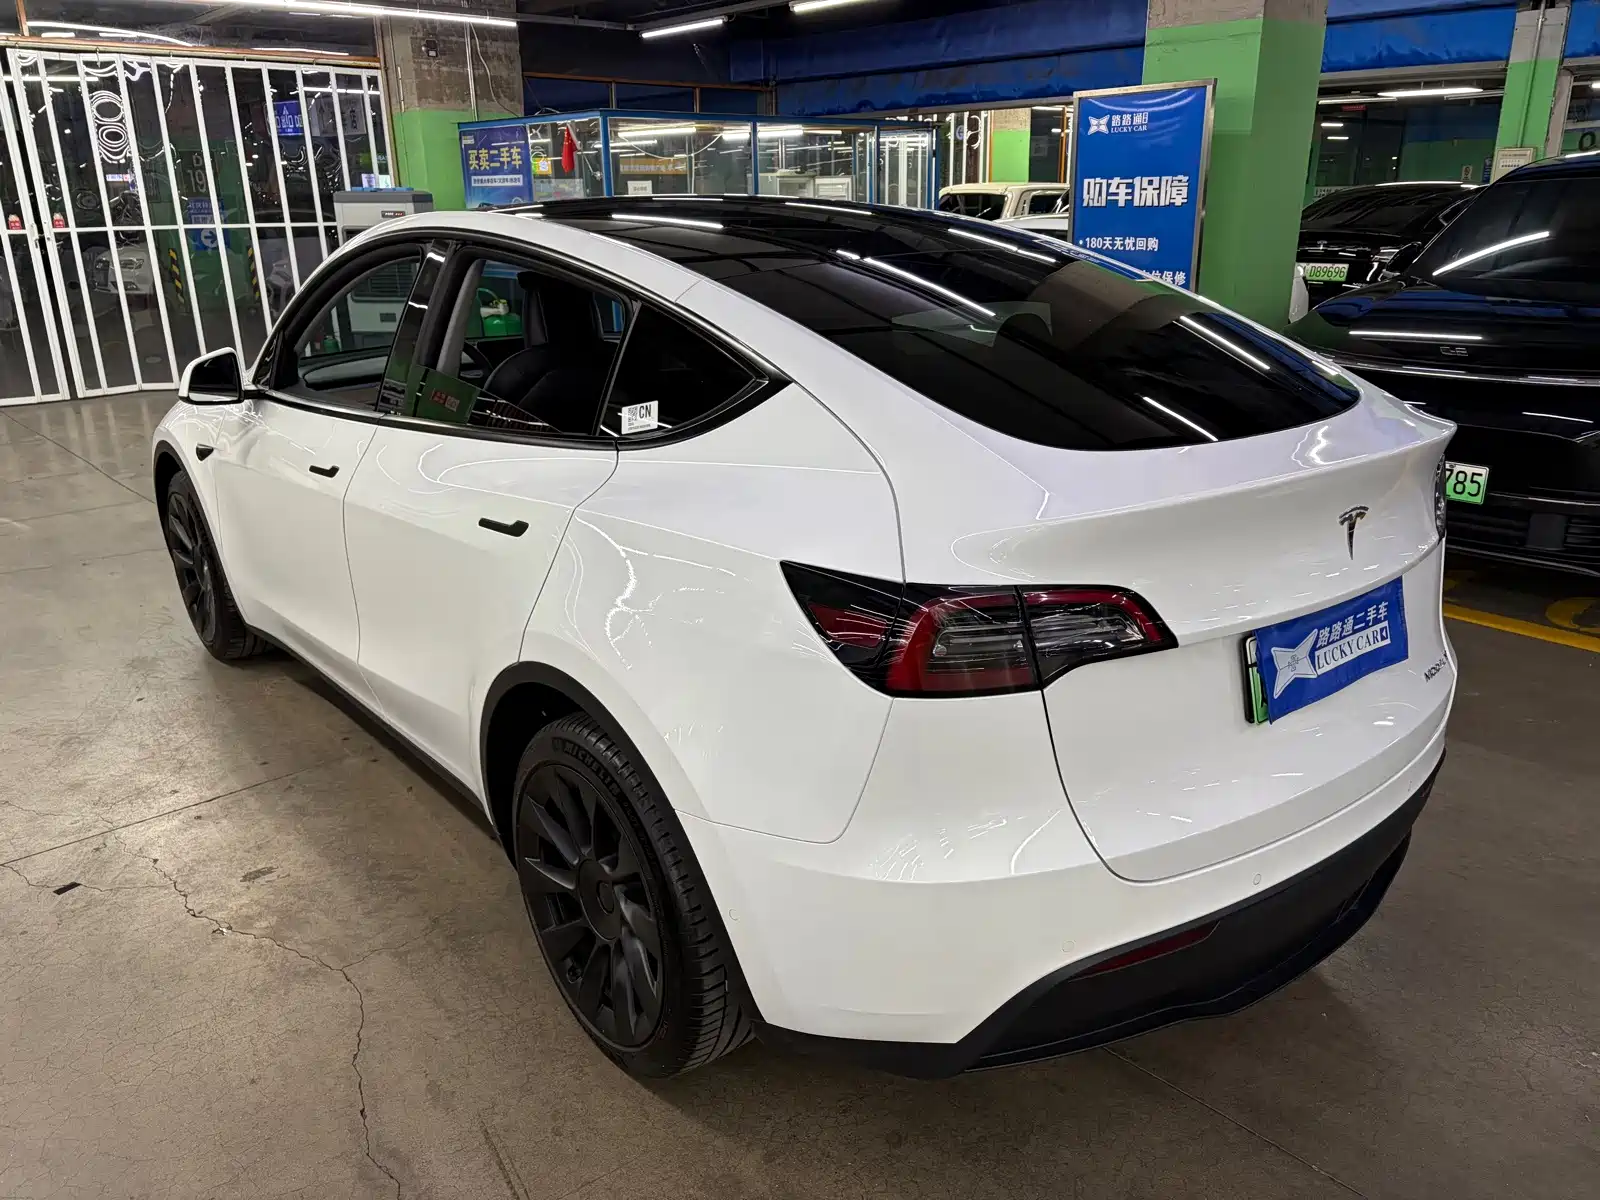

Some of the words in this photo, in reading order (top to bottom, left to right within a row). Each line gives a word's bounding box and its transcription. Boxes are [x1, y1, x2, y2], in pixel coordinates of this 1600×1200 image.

[1111, 126, 1132, 134] LUCKY
[468, 145, 523, 170] 买卖二手车
[1082, 174, 1189, 207] 购车保障
[1085, 236, 1159, 252] 180天无忧回购
[639, 403, 652, 419] CN
[1316, 601, 1389, 648] 路路通二手车
[1316, 638, 1355, 670] LUCKY
[1356, 629, 1380, 651] CAR
